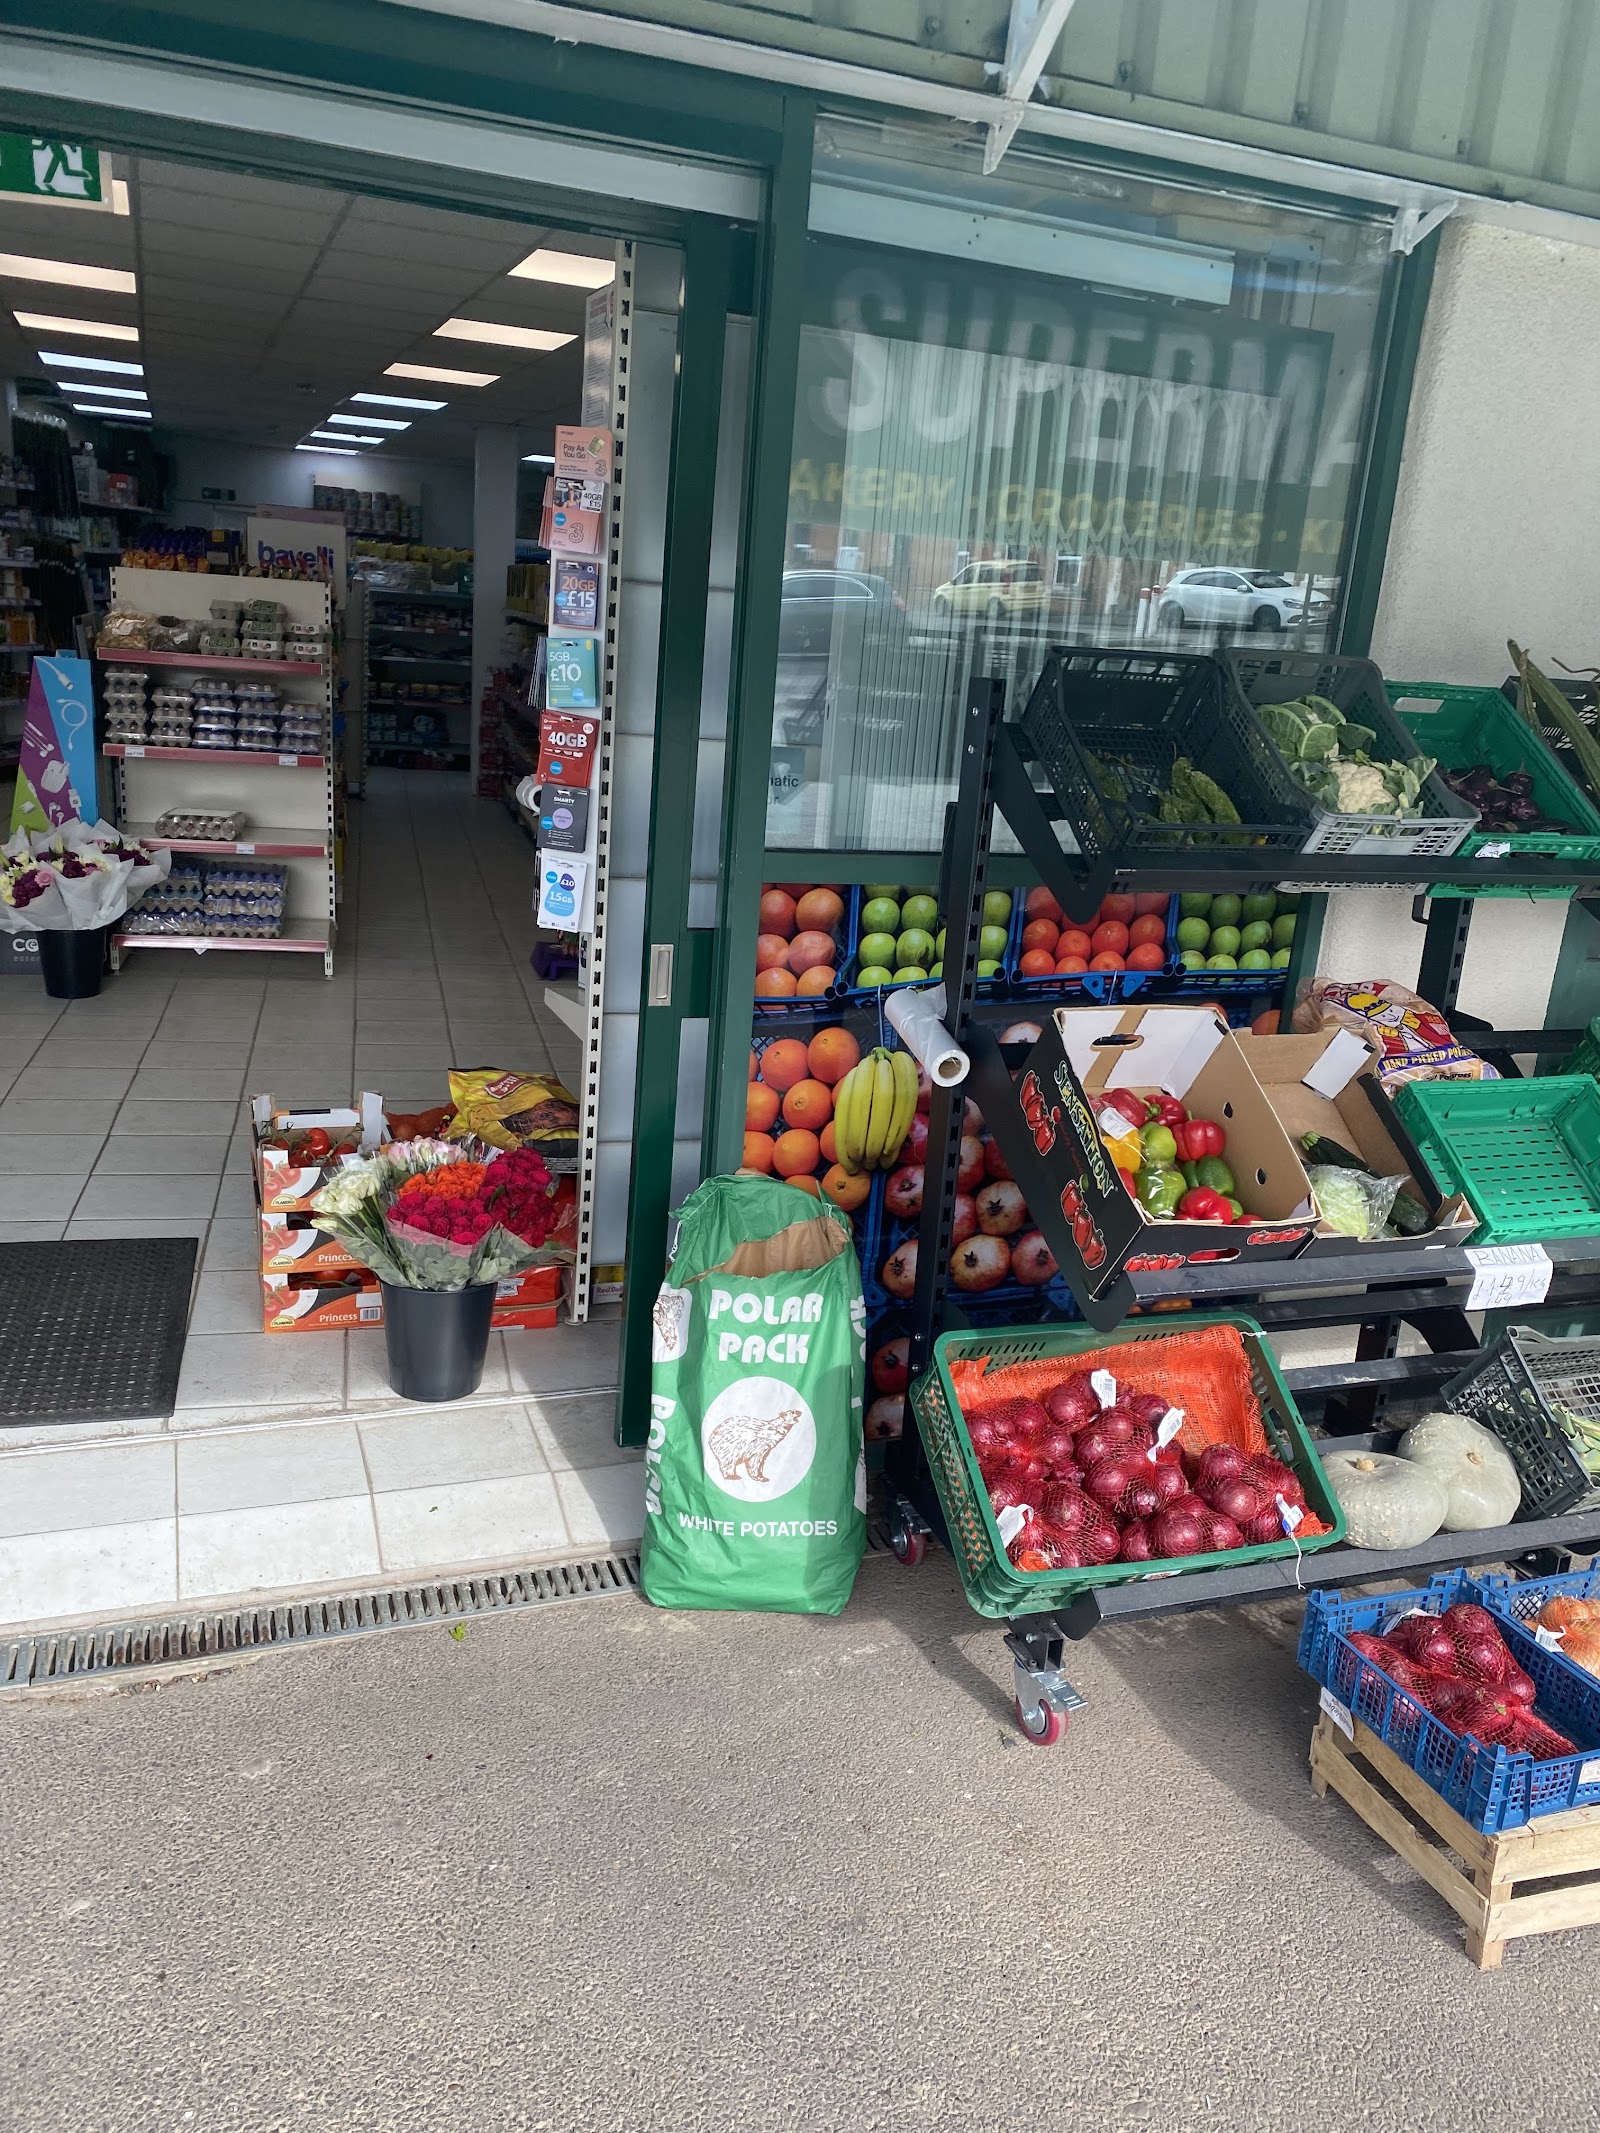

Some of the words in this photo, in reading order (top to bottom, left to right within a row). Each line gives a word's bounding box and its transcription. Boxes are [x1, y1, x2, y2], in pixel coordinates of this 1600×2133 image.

[563, 444, 575, 452] Pay
[595, 460, 607, 477] 3
[583, 493, 602, 501] 40GB
[590, 500, 602, 508] £15
[569, 522, 584, 544] 3
[562, 575, 596, 592] 20GB
[566, 590, 595, 608] £15
[549, 651, 570, 662] 5GB
[550, 663, 582, 682] £10
[548, 731, 588, 748] 40GB
[554, 796, 575, 804] SMARTY
[560, 878, 575, 887] £10
[549, 891, 574, 904] 15GB
[1382, 1056, 1408, 1072] HAND
[1411, 1049, 1447, 1065] PICKED
[1054, 1060, 1115, 1198] SENSATION
[1473, 1244, 1543, 1266] BANANA
[708, 1289, 824, 1325] POLAR
[320, 1313, 358, 1323] Princess
[718, 1332, 811, 1364] PACK
[645, 1393, 677, 1516] POLAR
[679, 1512, 735, 1537] WHITE
[740, 1519, 839, 1538] POTATOES
